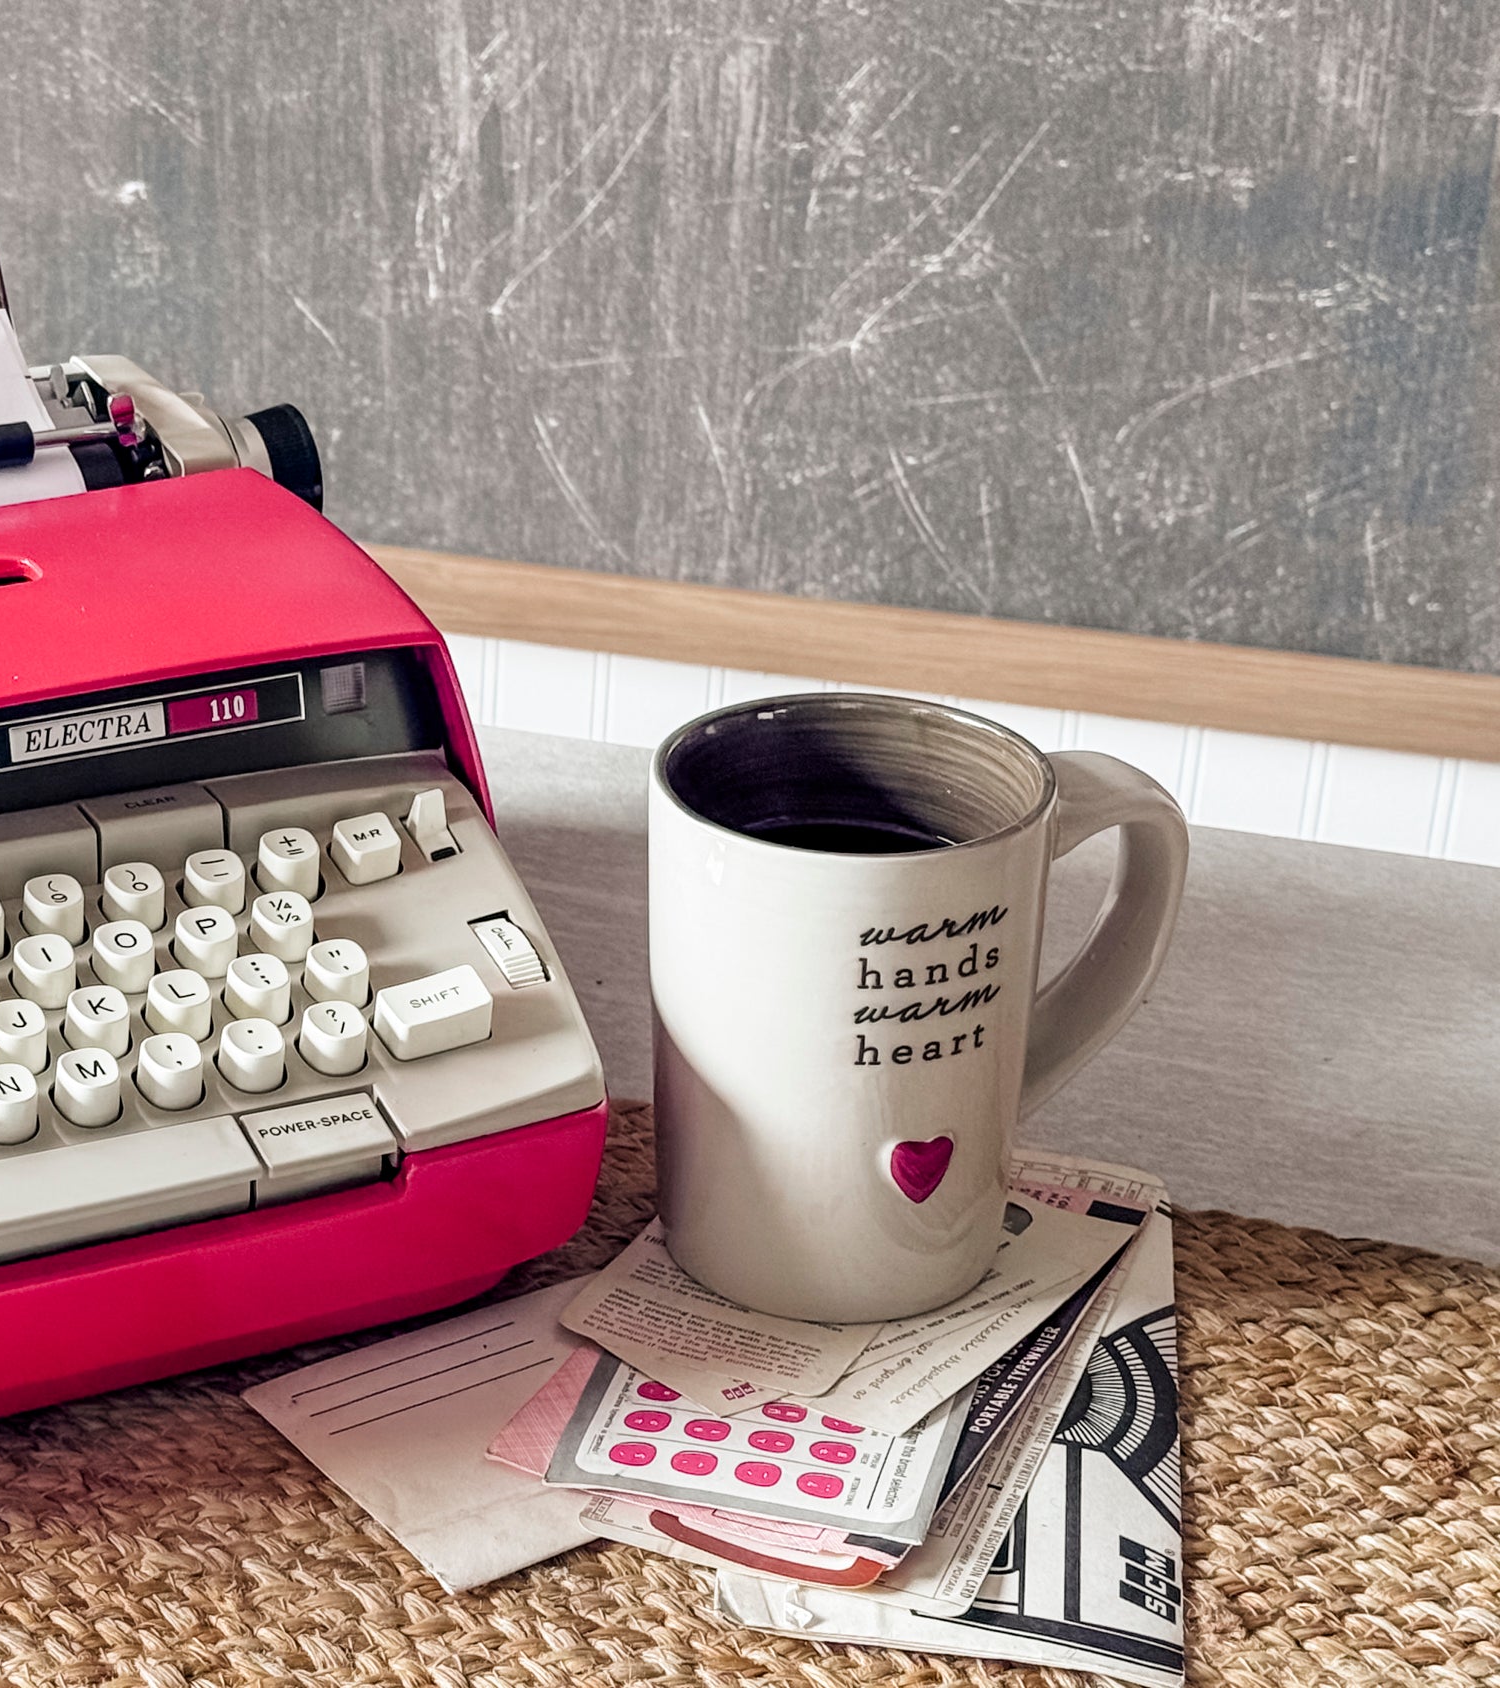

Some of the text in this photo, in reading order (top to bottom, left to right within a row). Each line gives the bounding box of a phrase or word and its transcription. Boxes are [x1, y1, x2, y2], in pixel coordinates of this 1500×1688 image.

[24, 695, 246, 754] ELECTRA 110
[123, 795, 177, 809] CLEAR
[114, 932, 138, 949] O
[195, 918, 217, 935] P
[859, 905, 1009, 947] warm
[41, 947, 52, 962] I
[857, 943, 1000, 990] hands
[87, 997, 114, 1015] K
[167, 983, 196, 999] L
[409, 989, 459, 1009] SHIFT
[854, 984, 1001, 1025] warm
[11, 1011, 28, 1028] J
[854, 1024, 985, 1066] heart
[75, 1060, 106, 1079] M
[257, 1109, 373, 1139] POWER-SPACE
[969, 1382, 1018, 1433] PORTABLE
[1007, 1327, 1061, 1381] TYPEWRITER
[1034, 1411, 1059, 1444] PORTABLE
[985, 1460, 1014, 1509] SMITH-CRONA
[970, 1529, 1001, 1577] REGISTRATION
[960, 1579, 978, 1599] CARD
[1136, 1544, 1177, 1618] SCM
